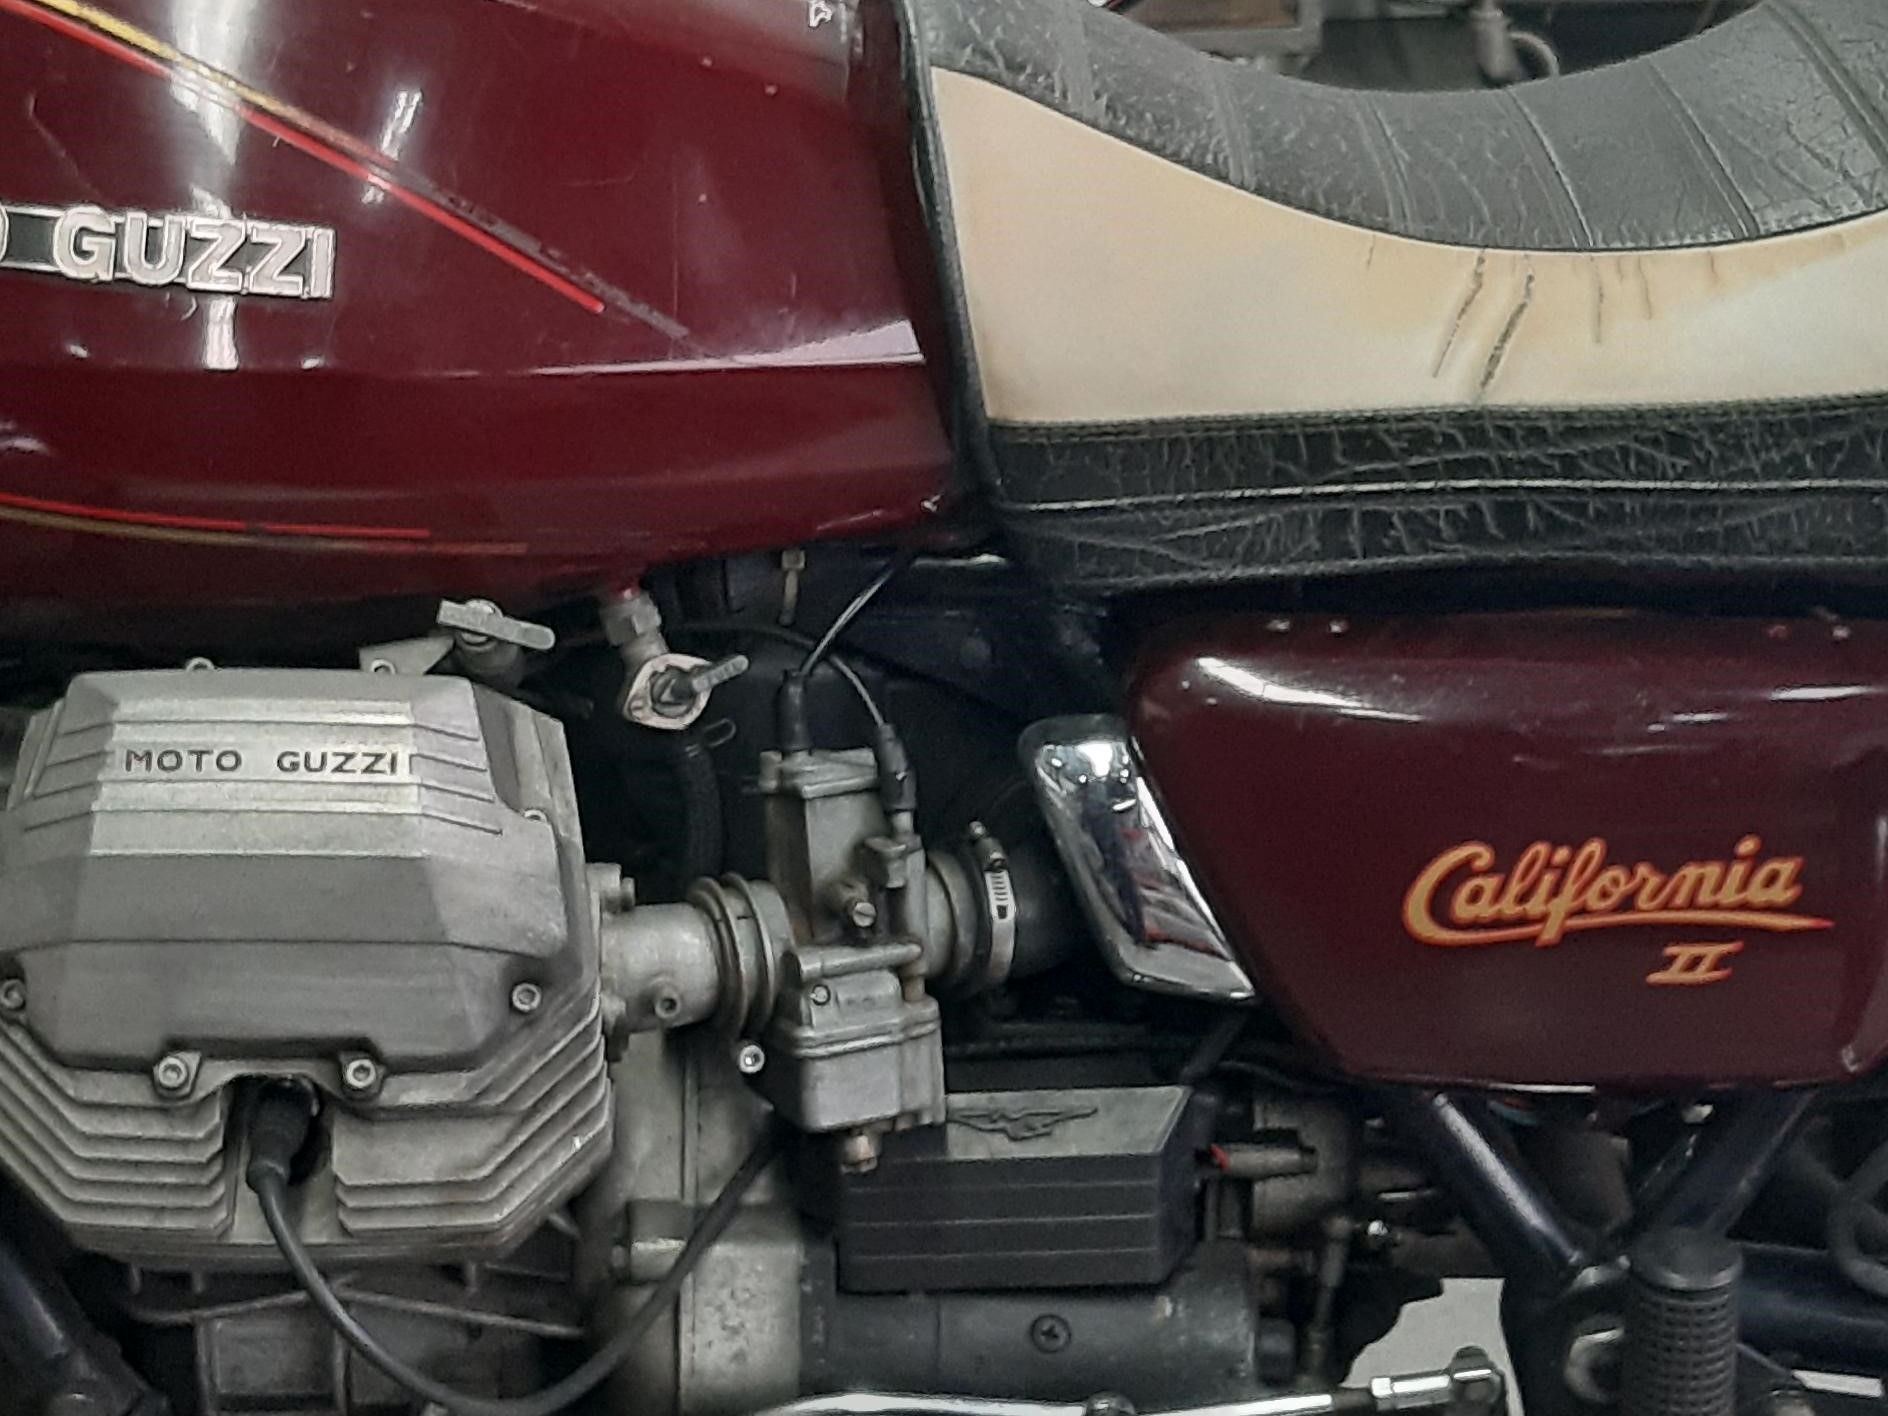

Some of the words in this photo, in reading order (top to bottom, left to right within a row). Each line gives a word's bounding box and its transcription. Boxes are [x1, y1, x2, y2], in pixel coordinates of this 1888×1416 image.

[53, 206, 338, 300] GUZZI
[125, 748, 242, 773] MOTO
[276, 750, 398, 775] GUZZI
[1402, 833, 1834, 948] California
[1645, 940, 1745, 985] II
